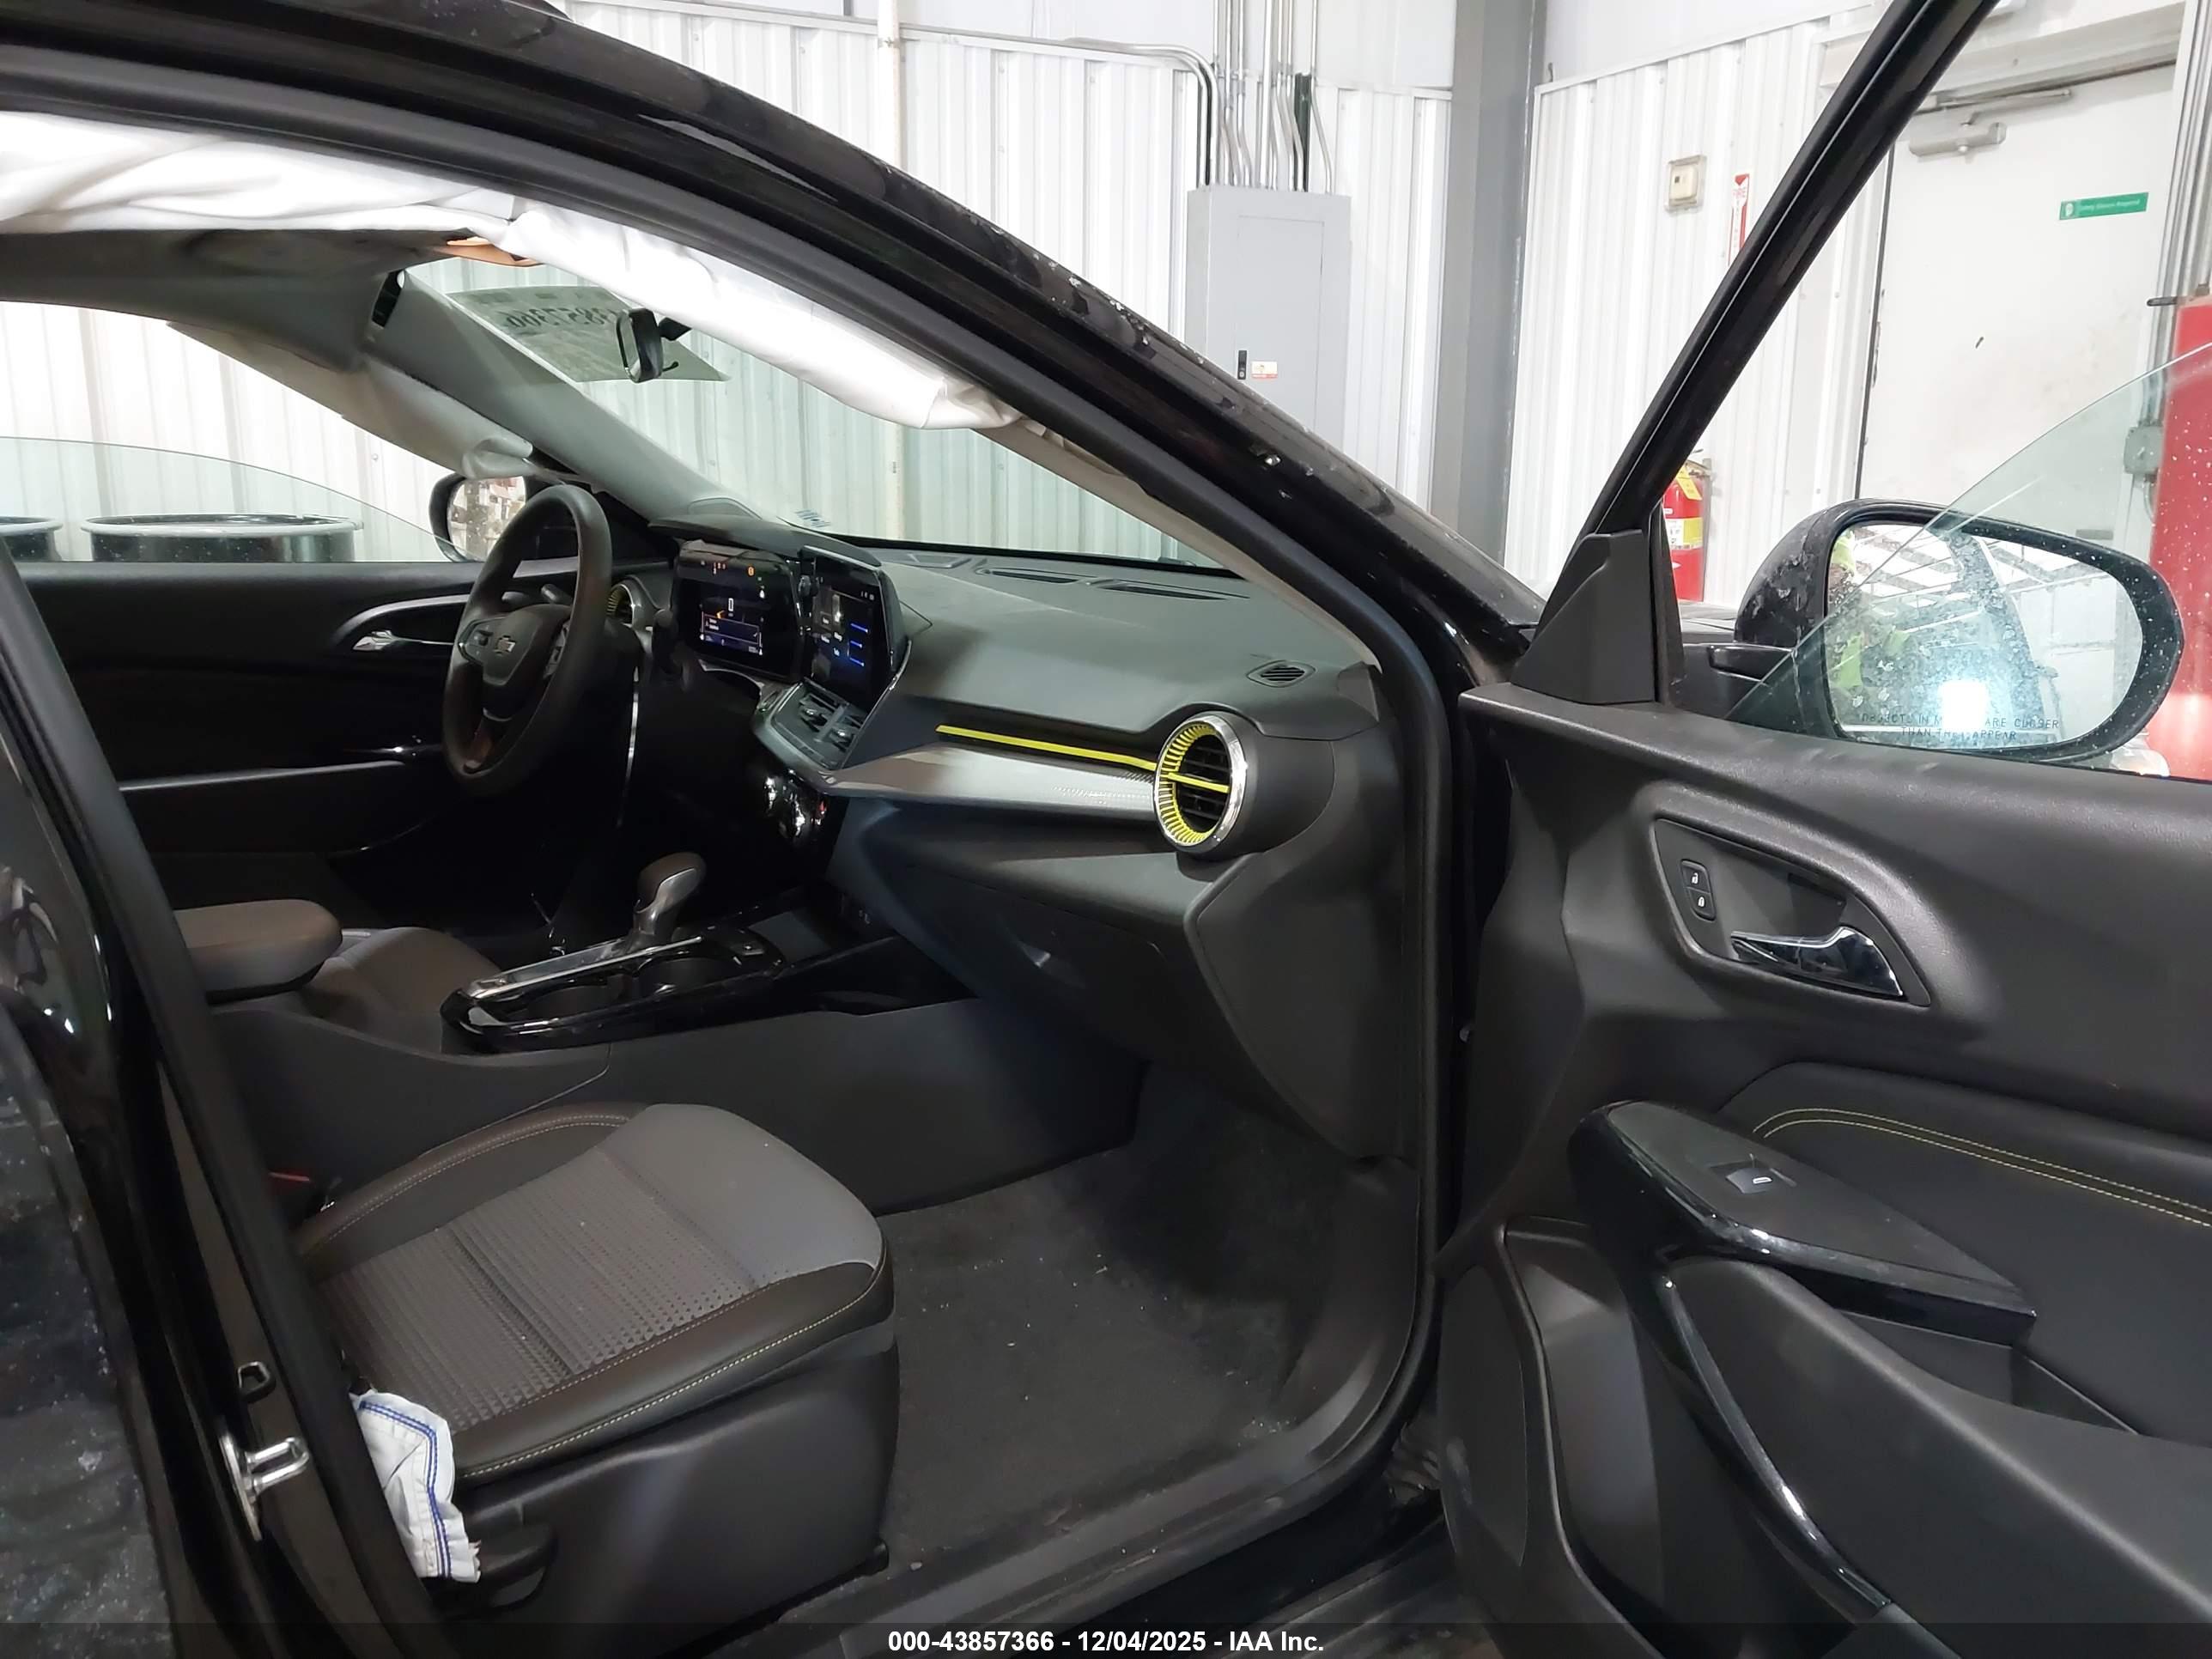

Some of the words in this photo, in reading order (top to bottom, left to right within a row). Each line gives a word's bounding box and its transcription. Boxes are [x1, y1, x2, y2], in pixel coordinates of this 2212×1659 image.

[1918, 714, 1929, 725] IN
[1984, 717, 2007, 727] ARE
[1901, 726, 1932, 737] THAN
[1972, 730, 2017, 740] APPEAR
